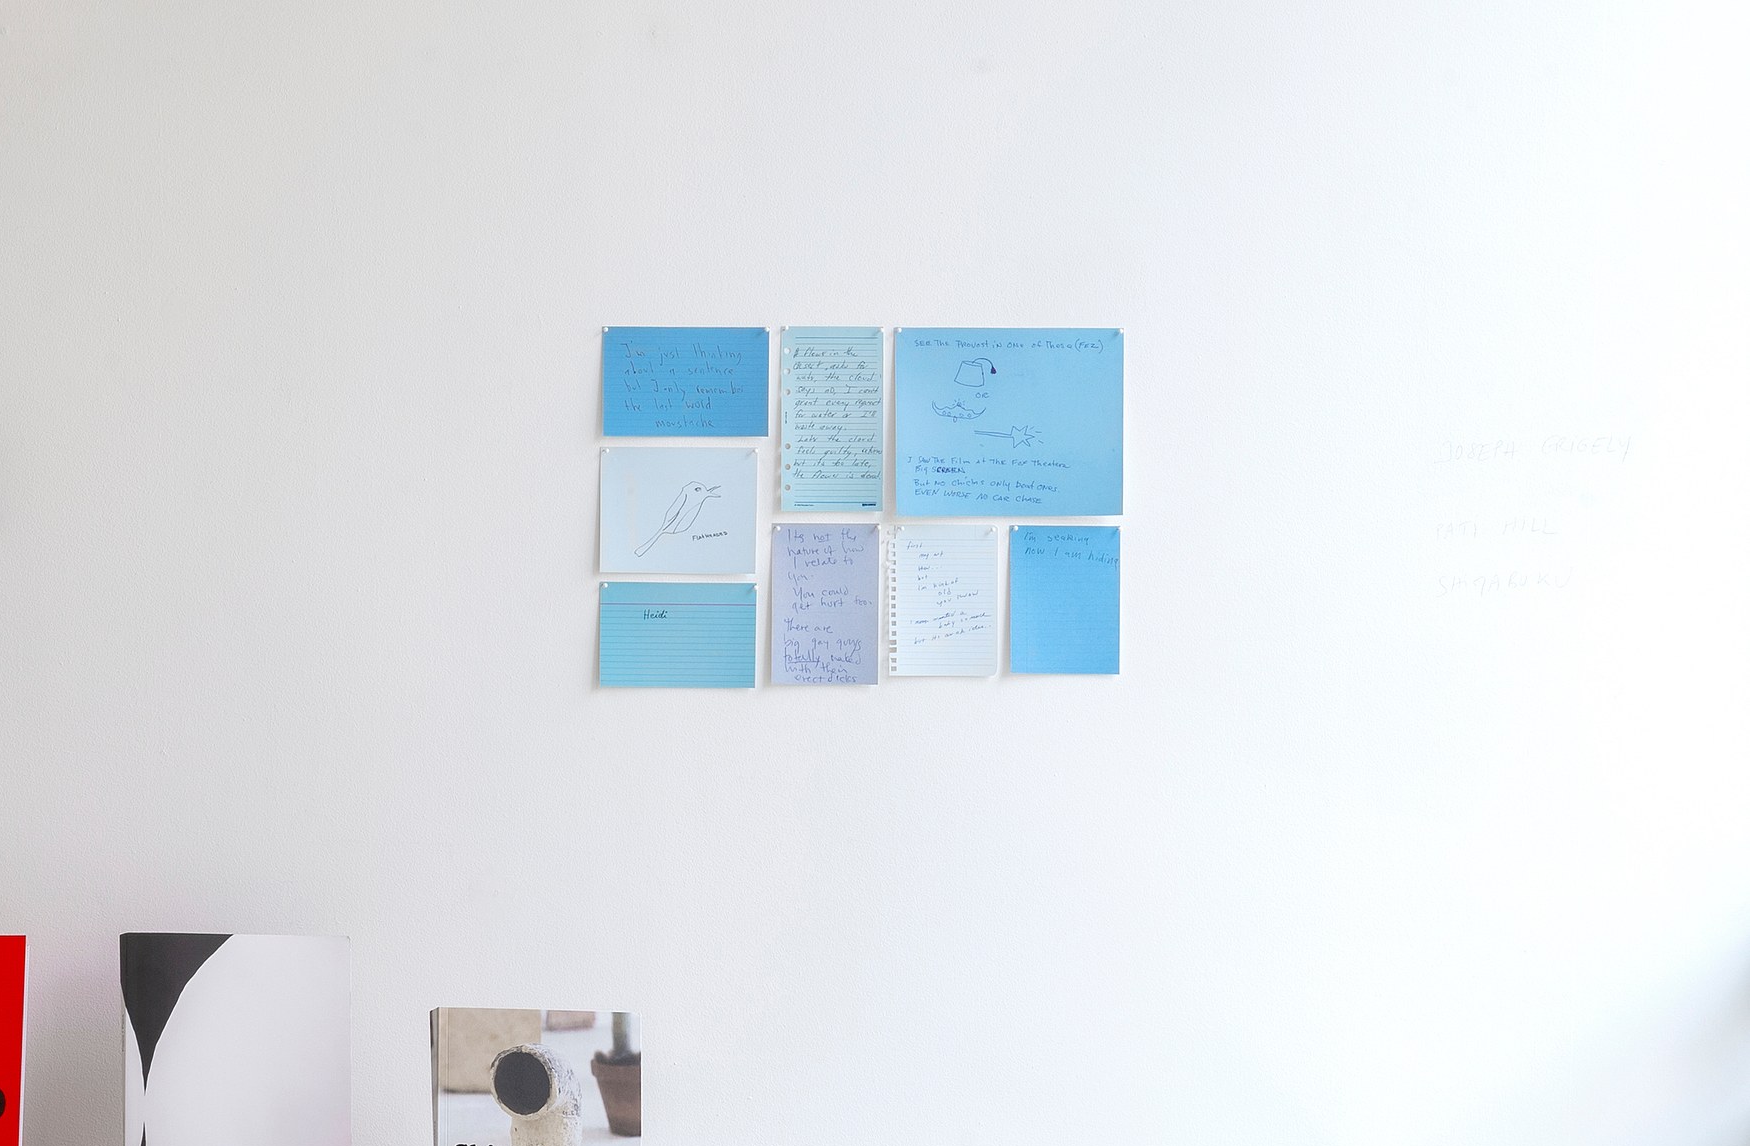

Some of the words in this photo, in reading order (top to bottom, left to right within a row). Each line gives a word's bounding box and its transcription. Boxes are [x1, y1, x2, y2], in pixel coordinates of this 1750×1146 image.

[620, 340, 645, 358] I'm
[658, 346, 680, 366] just
[693, 342, 742, 366] thinking
[844, 346, 858, 357] the
[625, 360, 654, 376] about
[688, 361, 734, 376] sentence
[825, 372, 840, 381] the
[849, 372, 875, 381] cloud
[624, 379, 641, 392] but
[651, 379, 658, 392] I
[664, 381, 686, 400] only
[696, 381, 744, 394] remember
[625, 399, 642, 411] the
[654, 398, 672, 411] last
[686, 397, 711, 410] word
[811, 409, 837, 418] water
[656, 414, 715, 428] moustache
[828, 432, 840, 442] the
[848, 432, 875, 442] cloud
[1502, 518, 1558, 536] HILL
[813, 533, 830, 541] not
[1024, 532, 1036, 542] I'm
[787, 546, 819, 556] nature
[842, 542, 865, 553] how
[805, 558, 837, 567] relate
[844, 556, 854, 565] to
[1025, 547, 1045, 555] now
[1055, 547, 1059, 556] I
[1088, 550, 1119, 571] hiding
[793, 587, 814, 602] You
[822, 585, 849, 596] could
[792, 602, 810, 614] get
[821, 597, 843, 608] hurt
[644, 609, 668, 620] Heidi
[814, 626, 833, 634] are
[784, 633, 800, 653] big
[811, 638, 829, 650] gay
[836, 638, 862, 657] guys
[783, 645, 820, 668] totally
[830, 653, 862, 665] naked
[785, 662, 812, 673] with
[794, 674, 828, 682] erect
[828, 672, 857, 682] dicks
